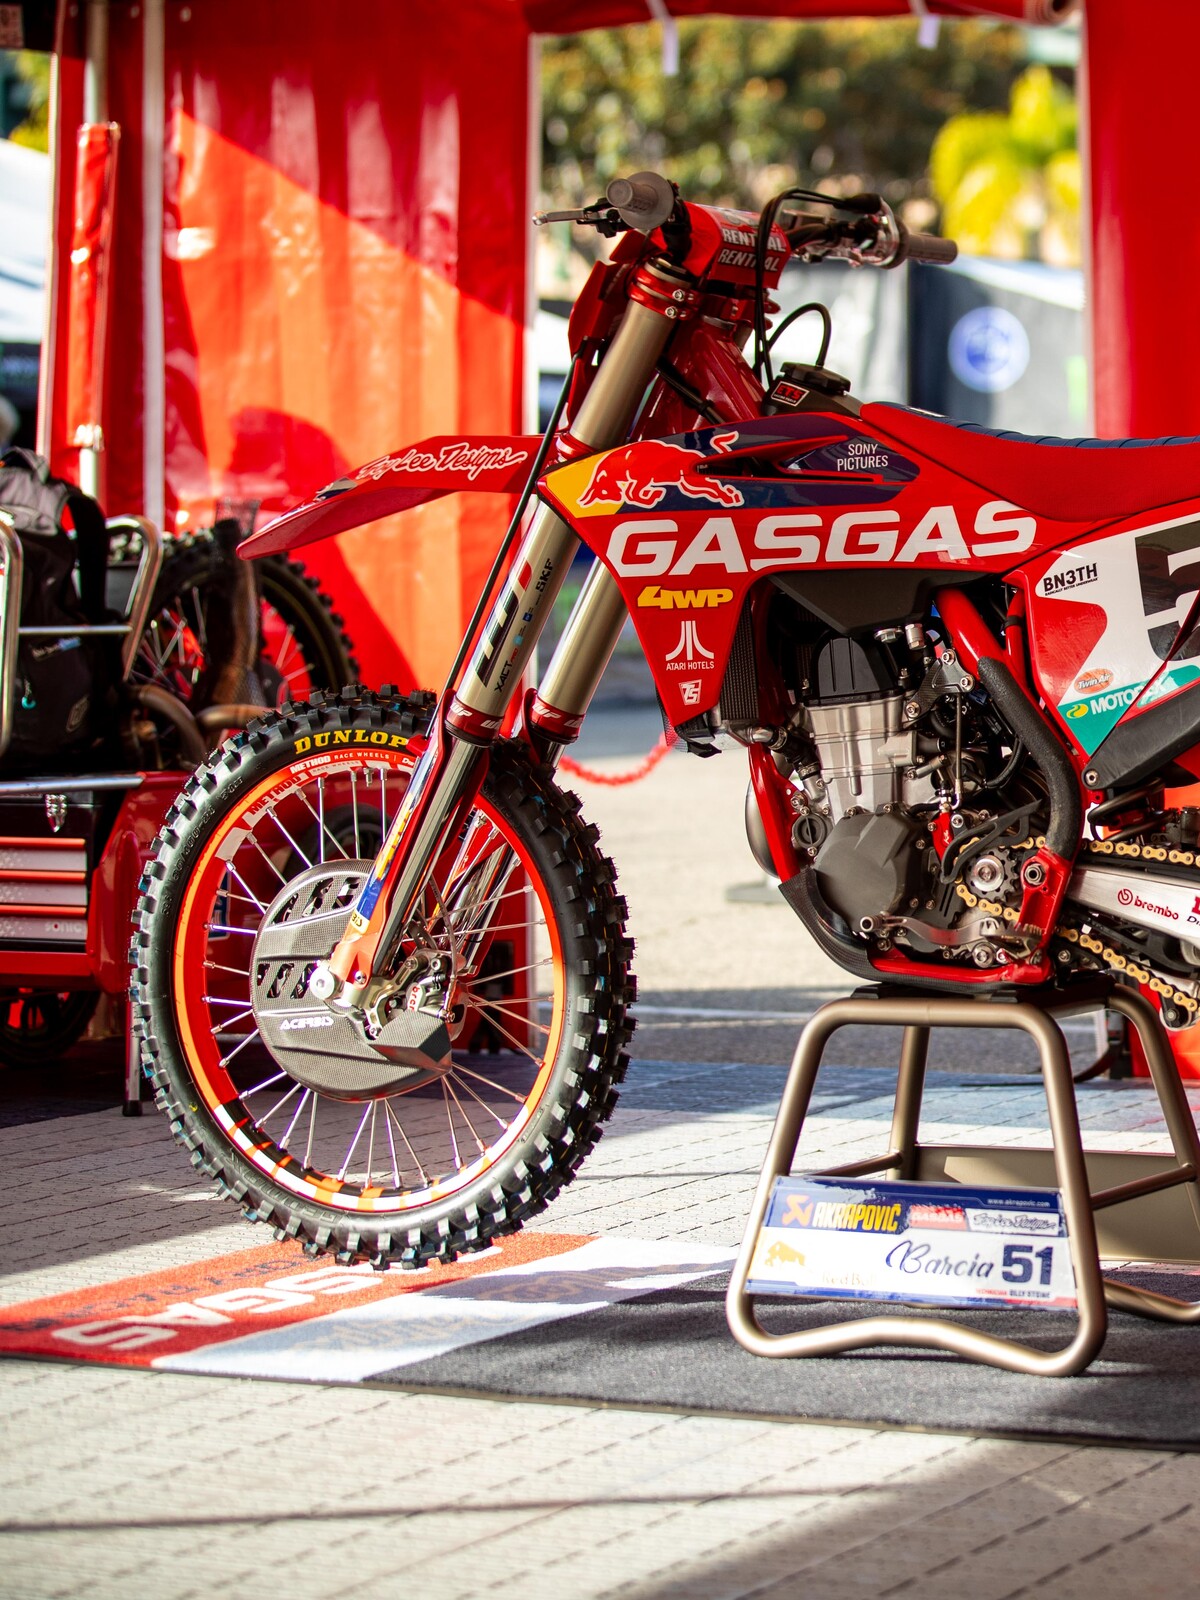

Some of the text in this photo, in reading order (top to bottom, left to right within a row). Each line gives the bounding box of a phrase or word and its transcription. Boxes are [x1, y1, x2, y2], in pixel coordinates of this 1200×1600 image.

[722, 228, 787, 253] RENTAL
[718, 248, 780, 272] RENTAL
[393, 449, 437, 472] Lee
[435, 442, 528, 480] Designs
[848, 443, 878, 456] SONY
[837, 455, 889, 472] PICTURES
[605, 500, 1037, 578] GASGAS
[535, 557, 554, 593] SKF
[1043, 562, 1098, 592] BN3TH
[494, 660, 513, 693] XACT
[665, 660, 715, 671] ATARI HOTELS
[294, 729, 409, 755] DUNLOP
[289, 752, 390, 775] METHOD RACE WHEELS
[1134, 895, 1179, 921] brembo
[885, 1239, 994, 1278] Barcia
[1001, 1244, 1054, 1286] 51
